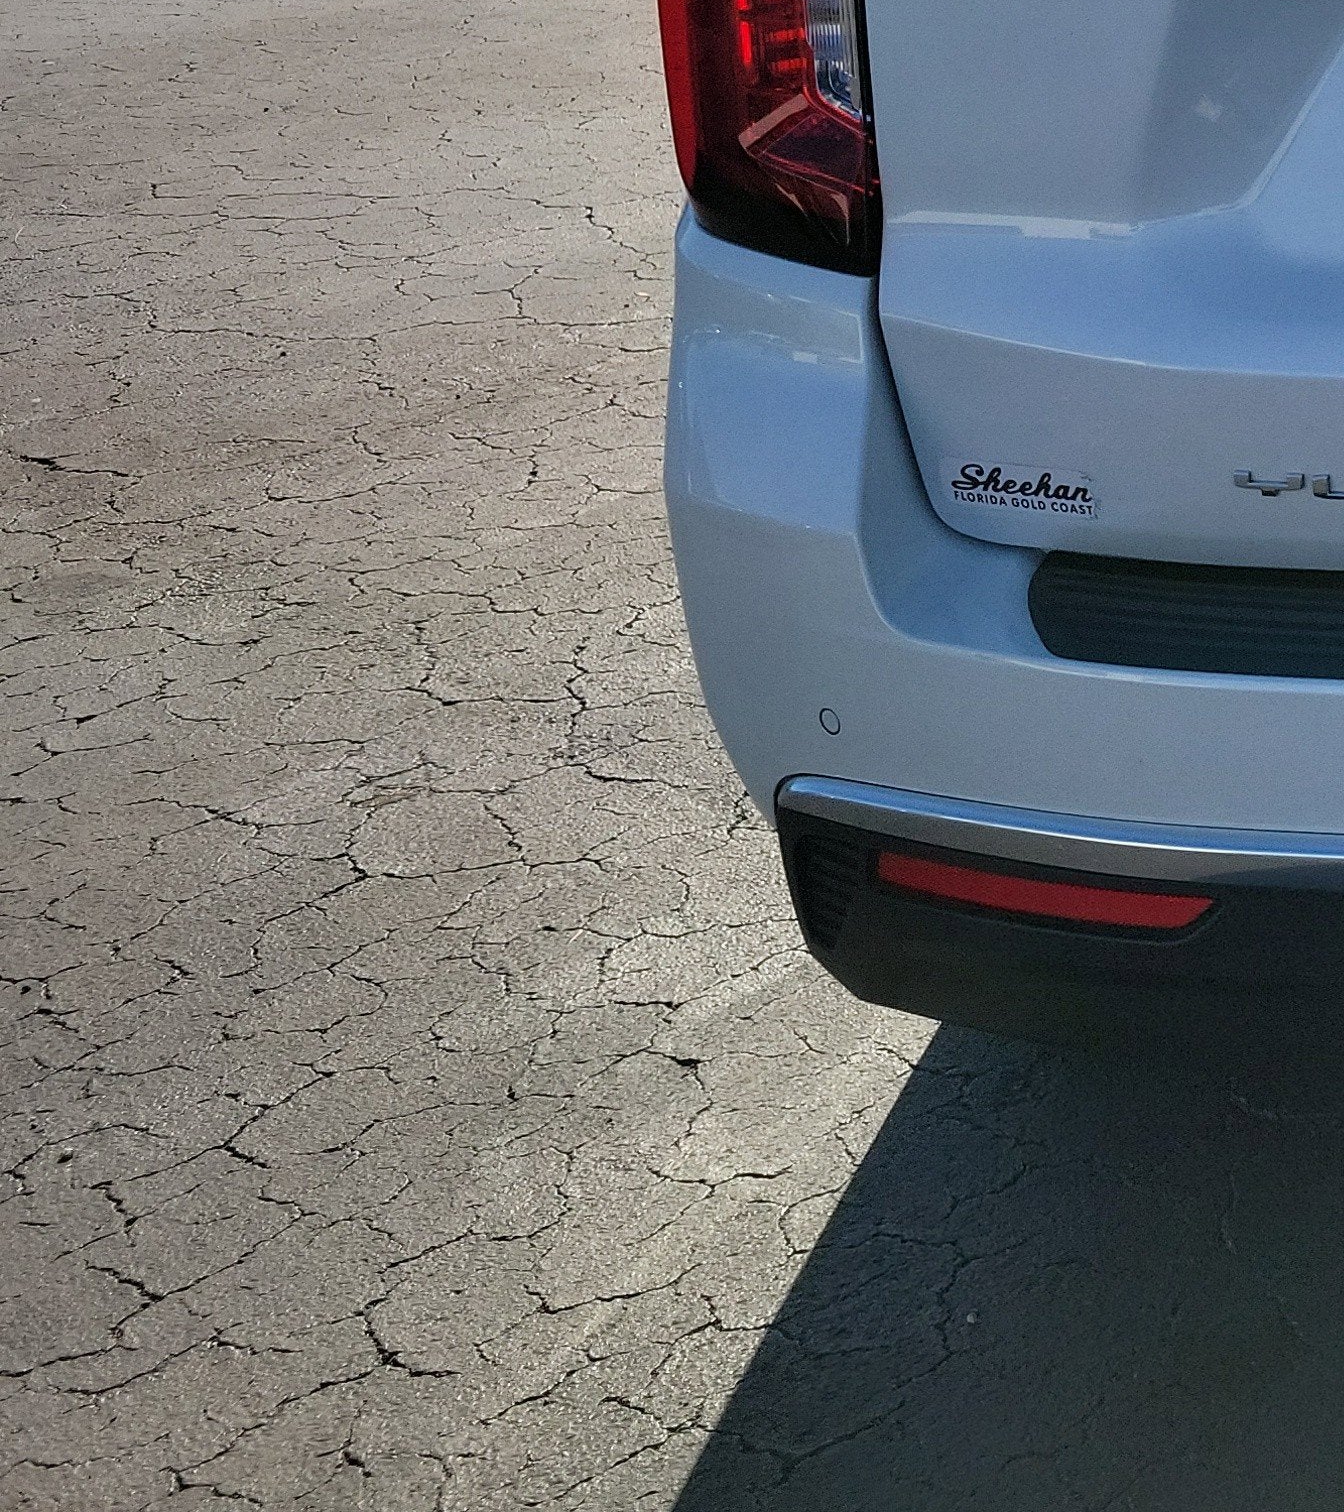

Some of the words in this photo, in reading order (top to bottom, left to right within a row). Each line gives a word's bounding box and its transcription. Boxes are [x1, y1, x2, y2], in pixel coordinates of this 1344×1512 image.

[951, 464, 1092, 502] Sheehan
[954, 491, 1007, 506] FLORIDA
[1011, 498, 1046, 510] GOLD
[1051, 502, 1093, 515] COAST
